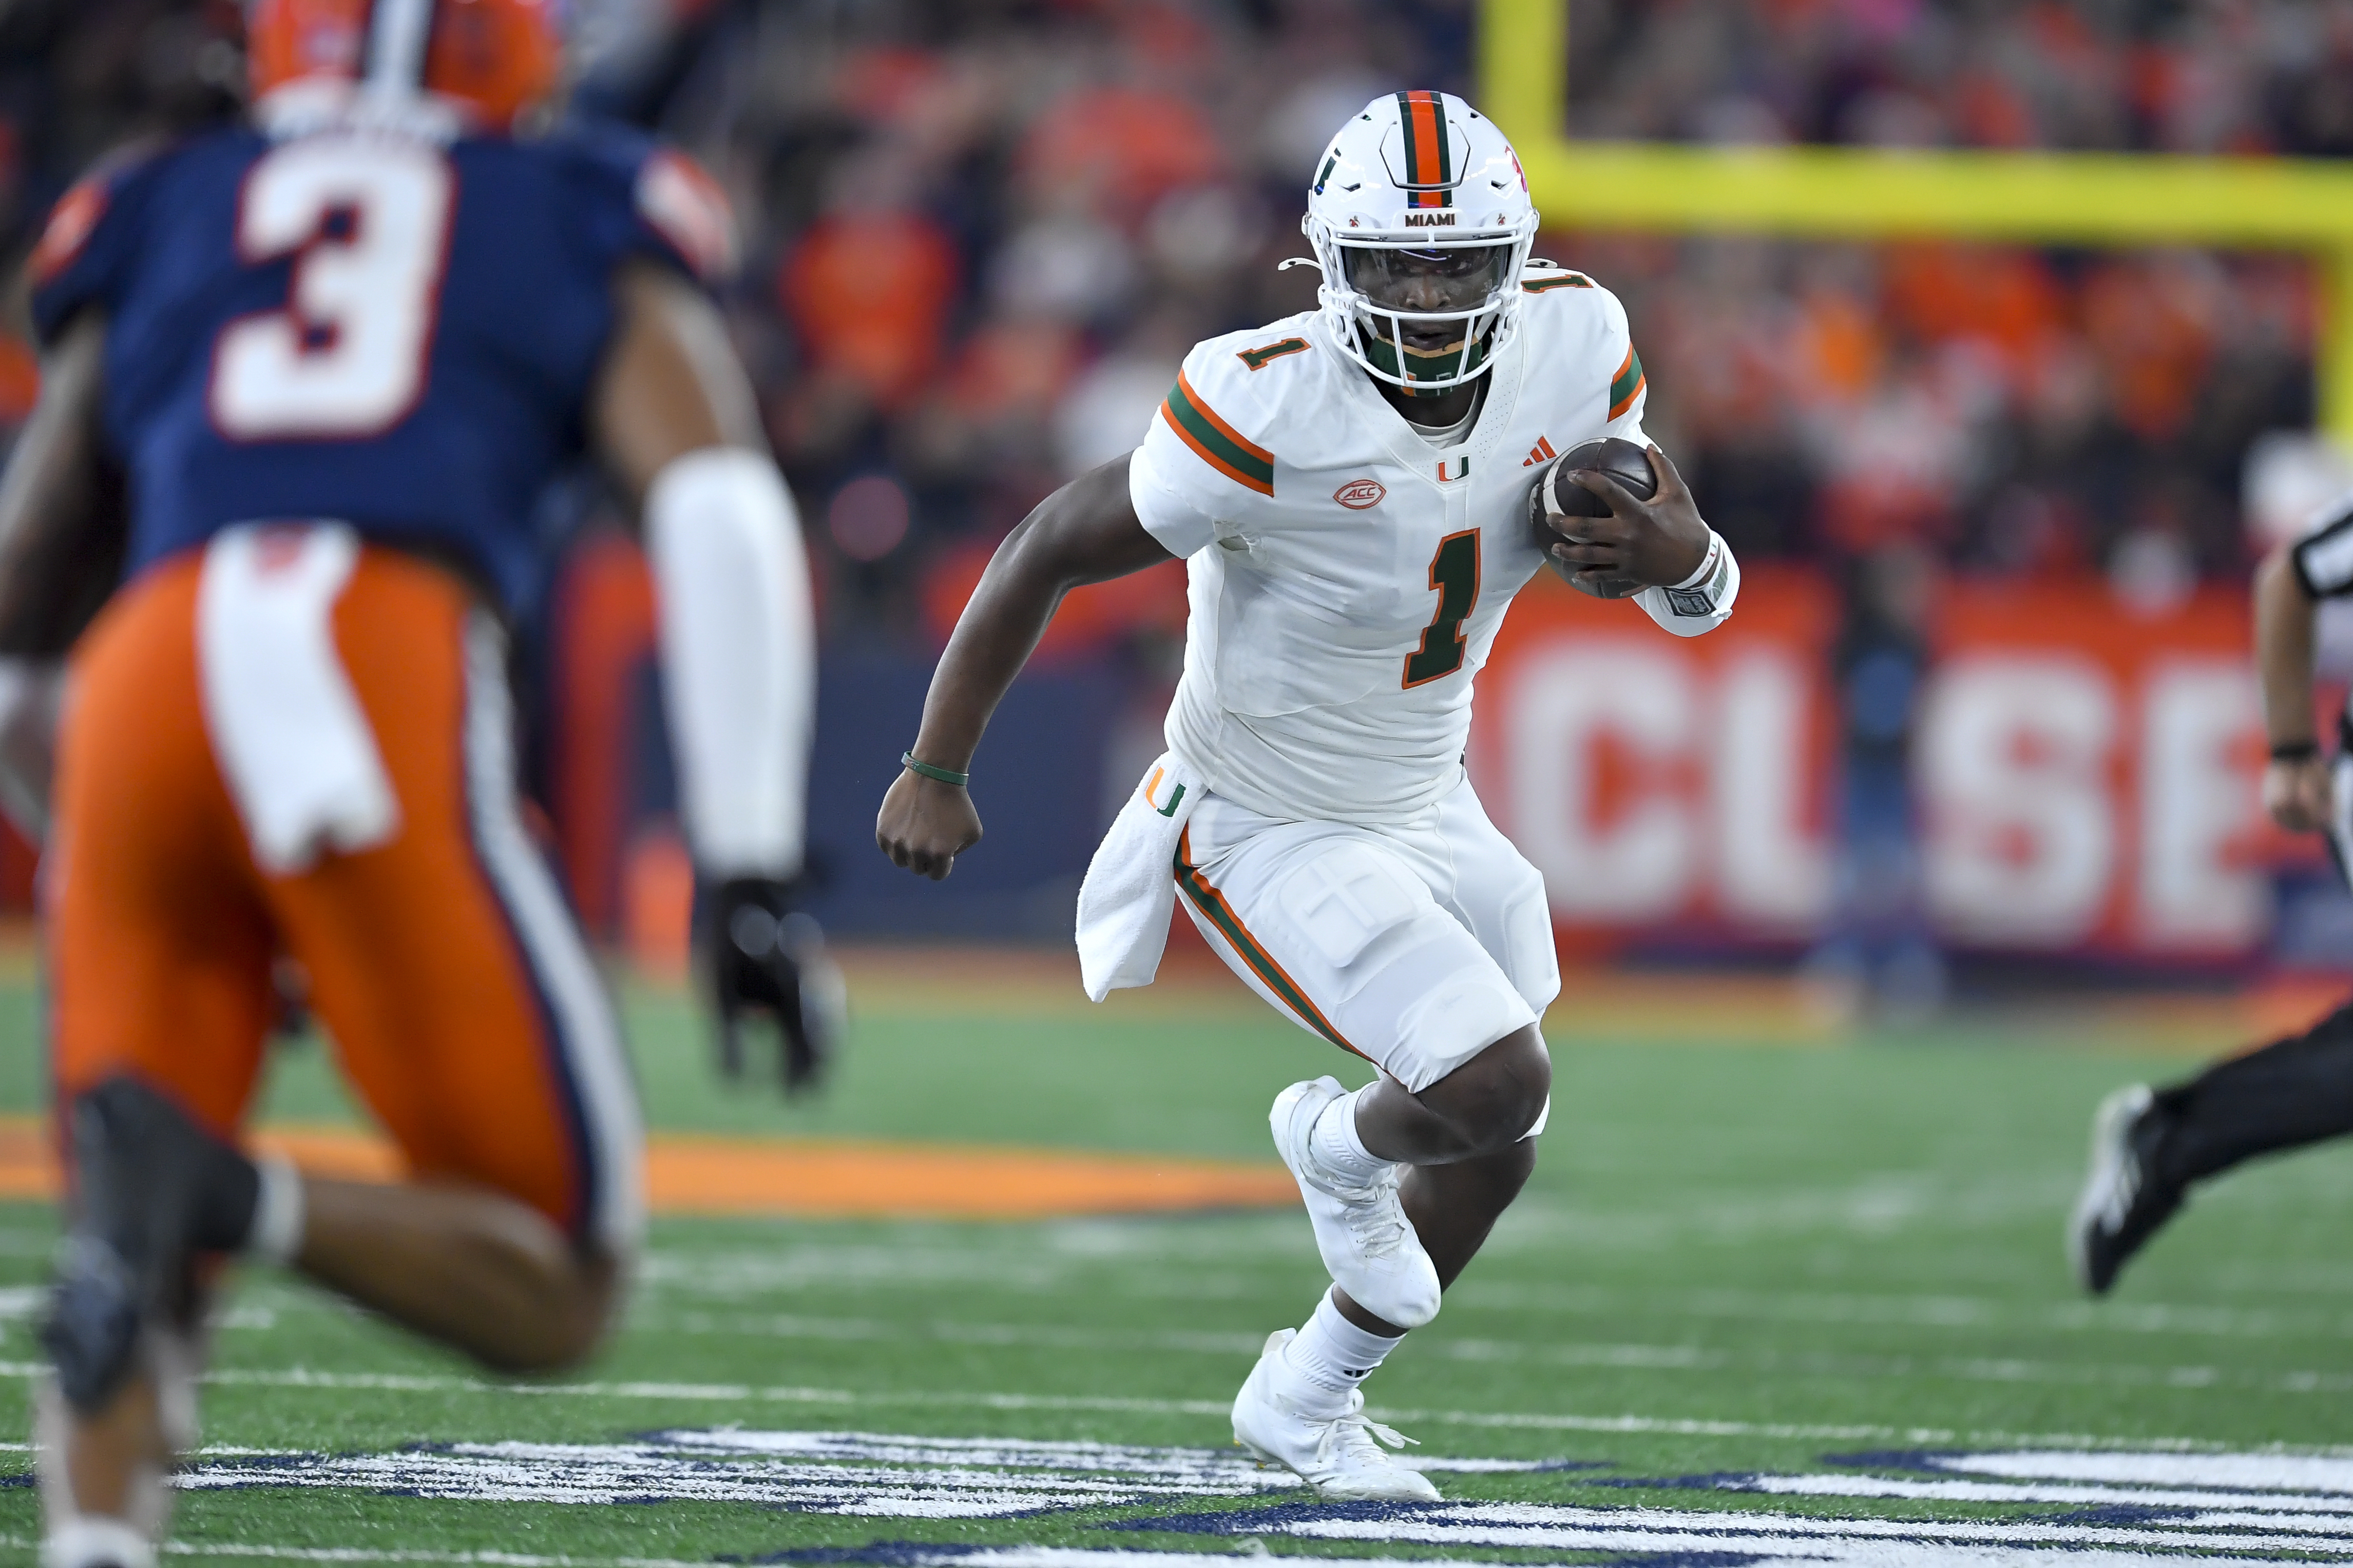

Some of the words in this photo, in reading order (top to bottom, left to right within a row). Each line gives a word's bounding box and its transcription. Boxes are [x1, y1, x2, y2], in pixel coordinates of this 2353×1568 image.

[1405, 213, 1455, 227] MIAMI
[212, 134, 457, 442] 3
[1236, 337, 1312, 372] 1
[1437, 455, 1470, 482] U
[1342, 487, 1376, 499] ACC
[1402, 528, 1481, 690] 1
[1145, 766, 1187, 818] U
